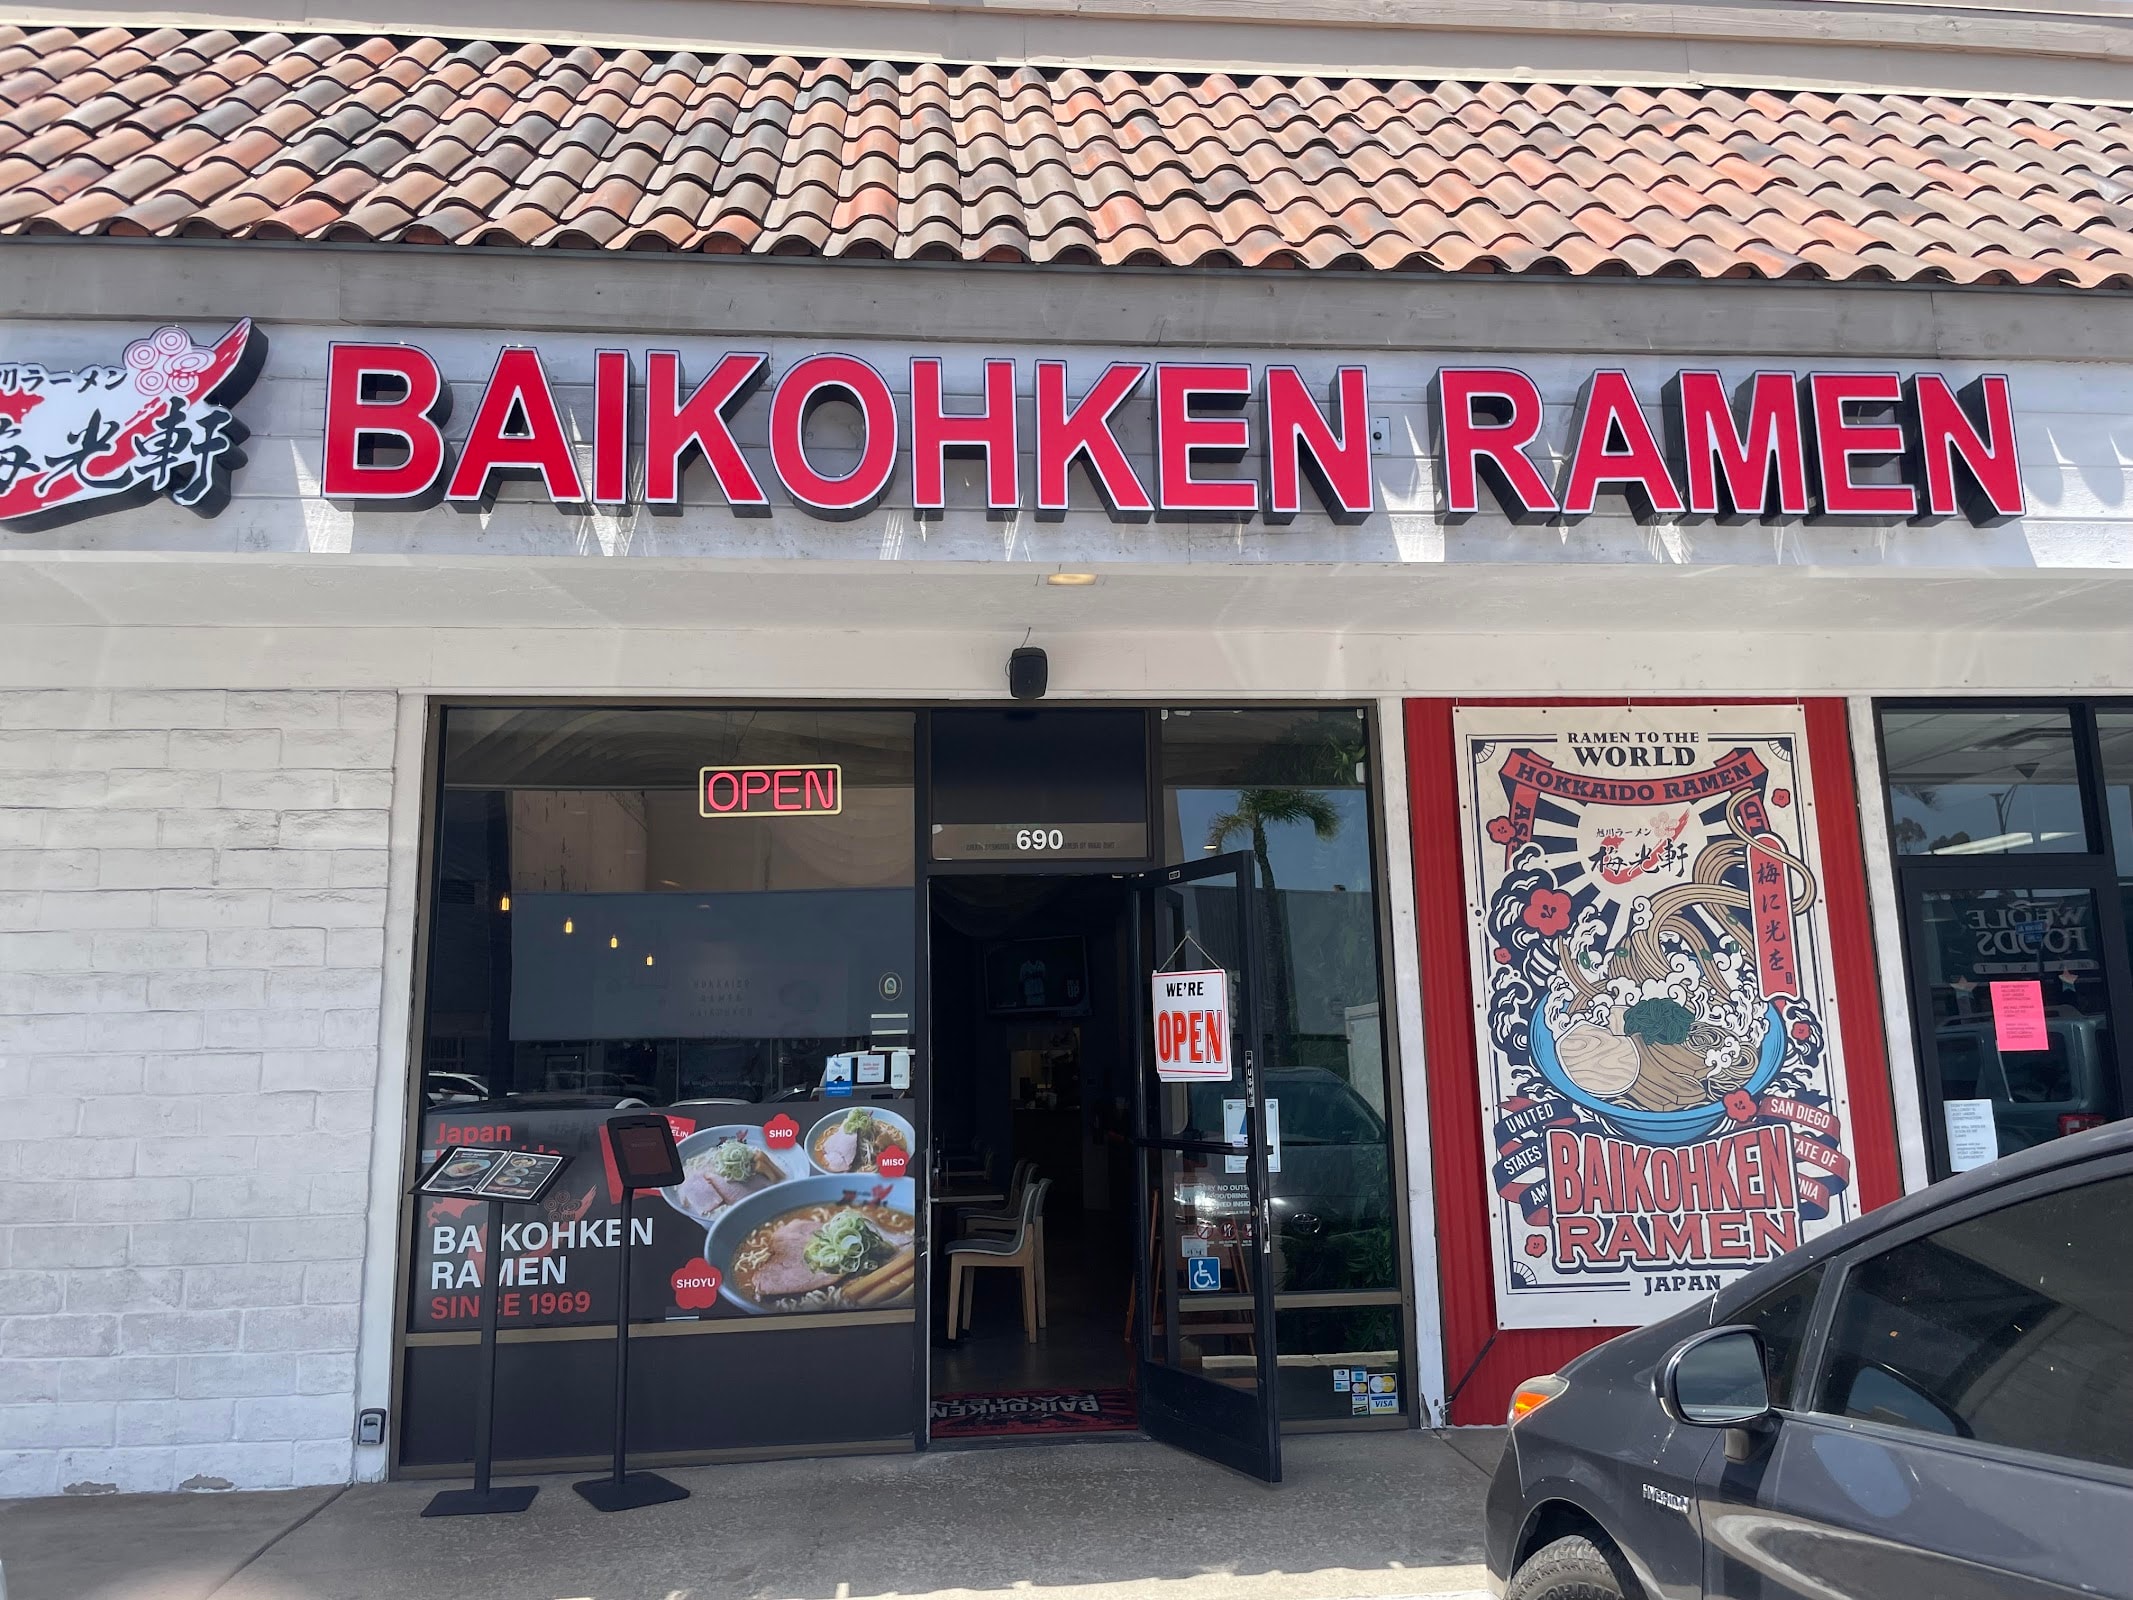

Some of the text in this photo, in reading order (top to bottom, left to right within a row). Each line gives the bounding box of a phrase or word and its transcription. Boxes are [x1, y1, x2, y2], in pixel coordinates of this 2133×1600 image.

[322, 341, 2026, 519] BAIKOHKEN RAMEN
[1568, 732, 1699, 743] RAMEN TO THE
[1572, 746, 1696, 767] WORLD
[708, 770, 834, 811] OPEN
[1515, 761, 1753, 801] HOKKAIDO RAMEN
[1016, 829, 1064, 850] 690
[1588, 837, 1689, 878] 梅光軒
[1166, 982, 1204, 997] WE'RE
[1157, 1010, 1223, 1063] OPEN
[1505, 1103, 1554, 1133] UNITED
[1771, 1098, 1830, 1129] SAN DIEGO
[435, 1123, 512, 1146] Japan
[769, 1129, 793, 1138] SHIO
[881, 1157, 905, 1166] MISO
[1504, 1145, 1542, 1175] STATES
[1551, 1125, 1794, 1213] BAIKOHKEN
[1820, 1150, 1839, 1168] OF
[433, 1218, 654, 1254] BAKOHKEN
[1556, 1211, 1799, 1264] RAMEN
[676, 1278, 715, 1288] SHOYU
[1644, 1275, 1720, 1296] JAPAN
[431, 1290, 591, 1319] SINE 1969
[1375, 1400, 1393, 1408] VISA
